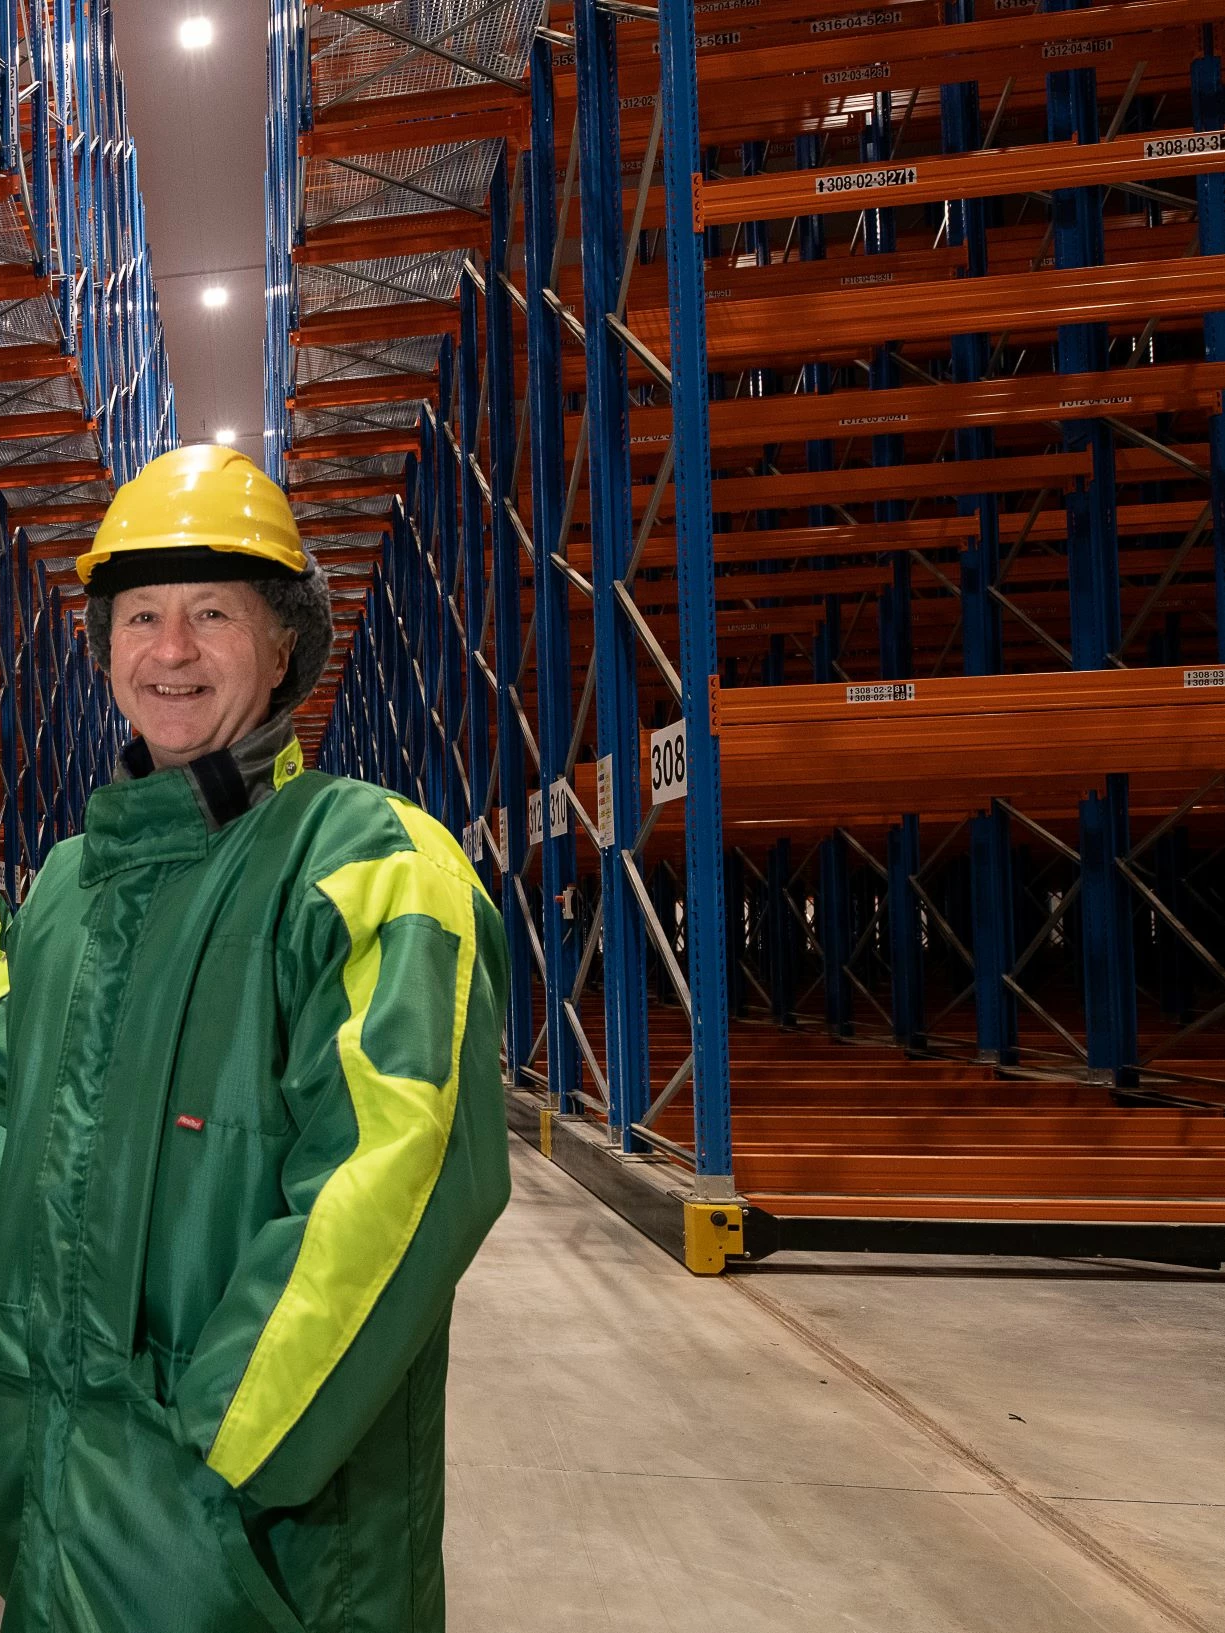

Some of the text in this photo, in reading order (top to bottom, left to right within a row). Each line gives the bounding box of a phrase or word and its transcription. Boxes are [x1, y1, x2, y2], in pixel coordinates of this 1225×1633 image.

[623, 96, 654, 109] 312·02·
[1156, 136, 1225, 156] 308·03·3
[827, 169, 905, 192] 308·02·327
[652, 734, 685, 790] 308
[529, 800, 542, 834] 312
[550, 788, 566, 827] 310
